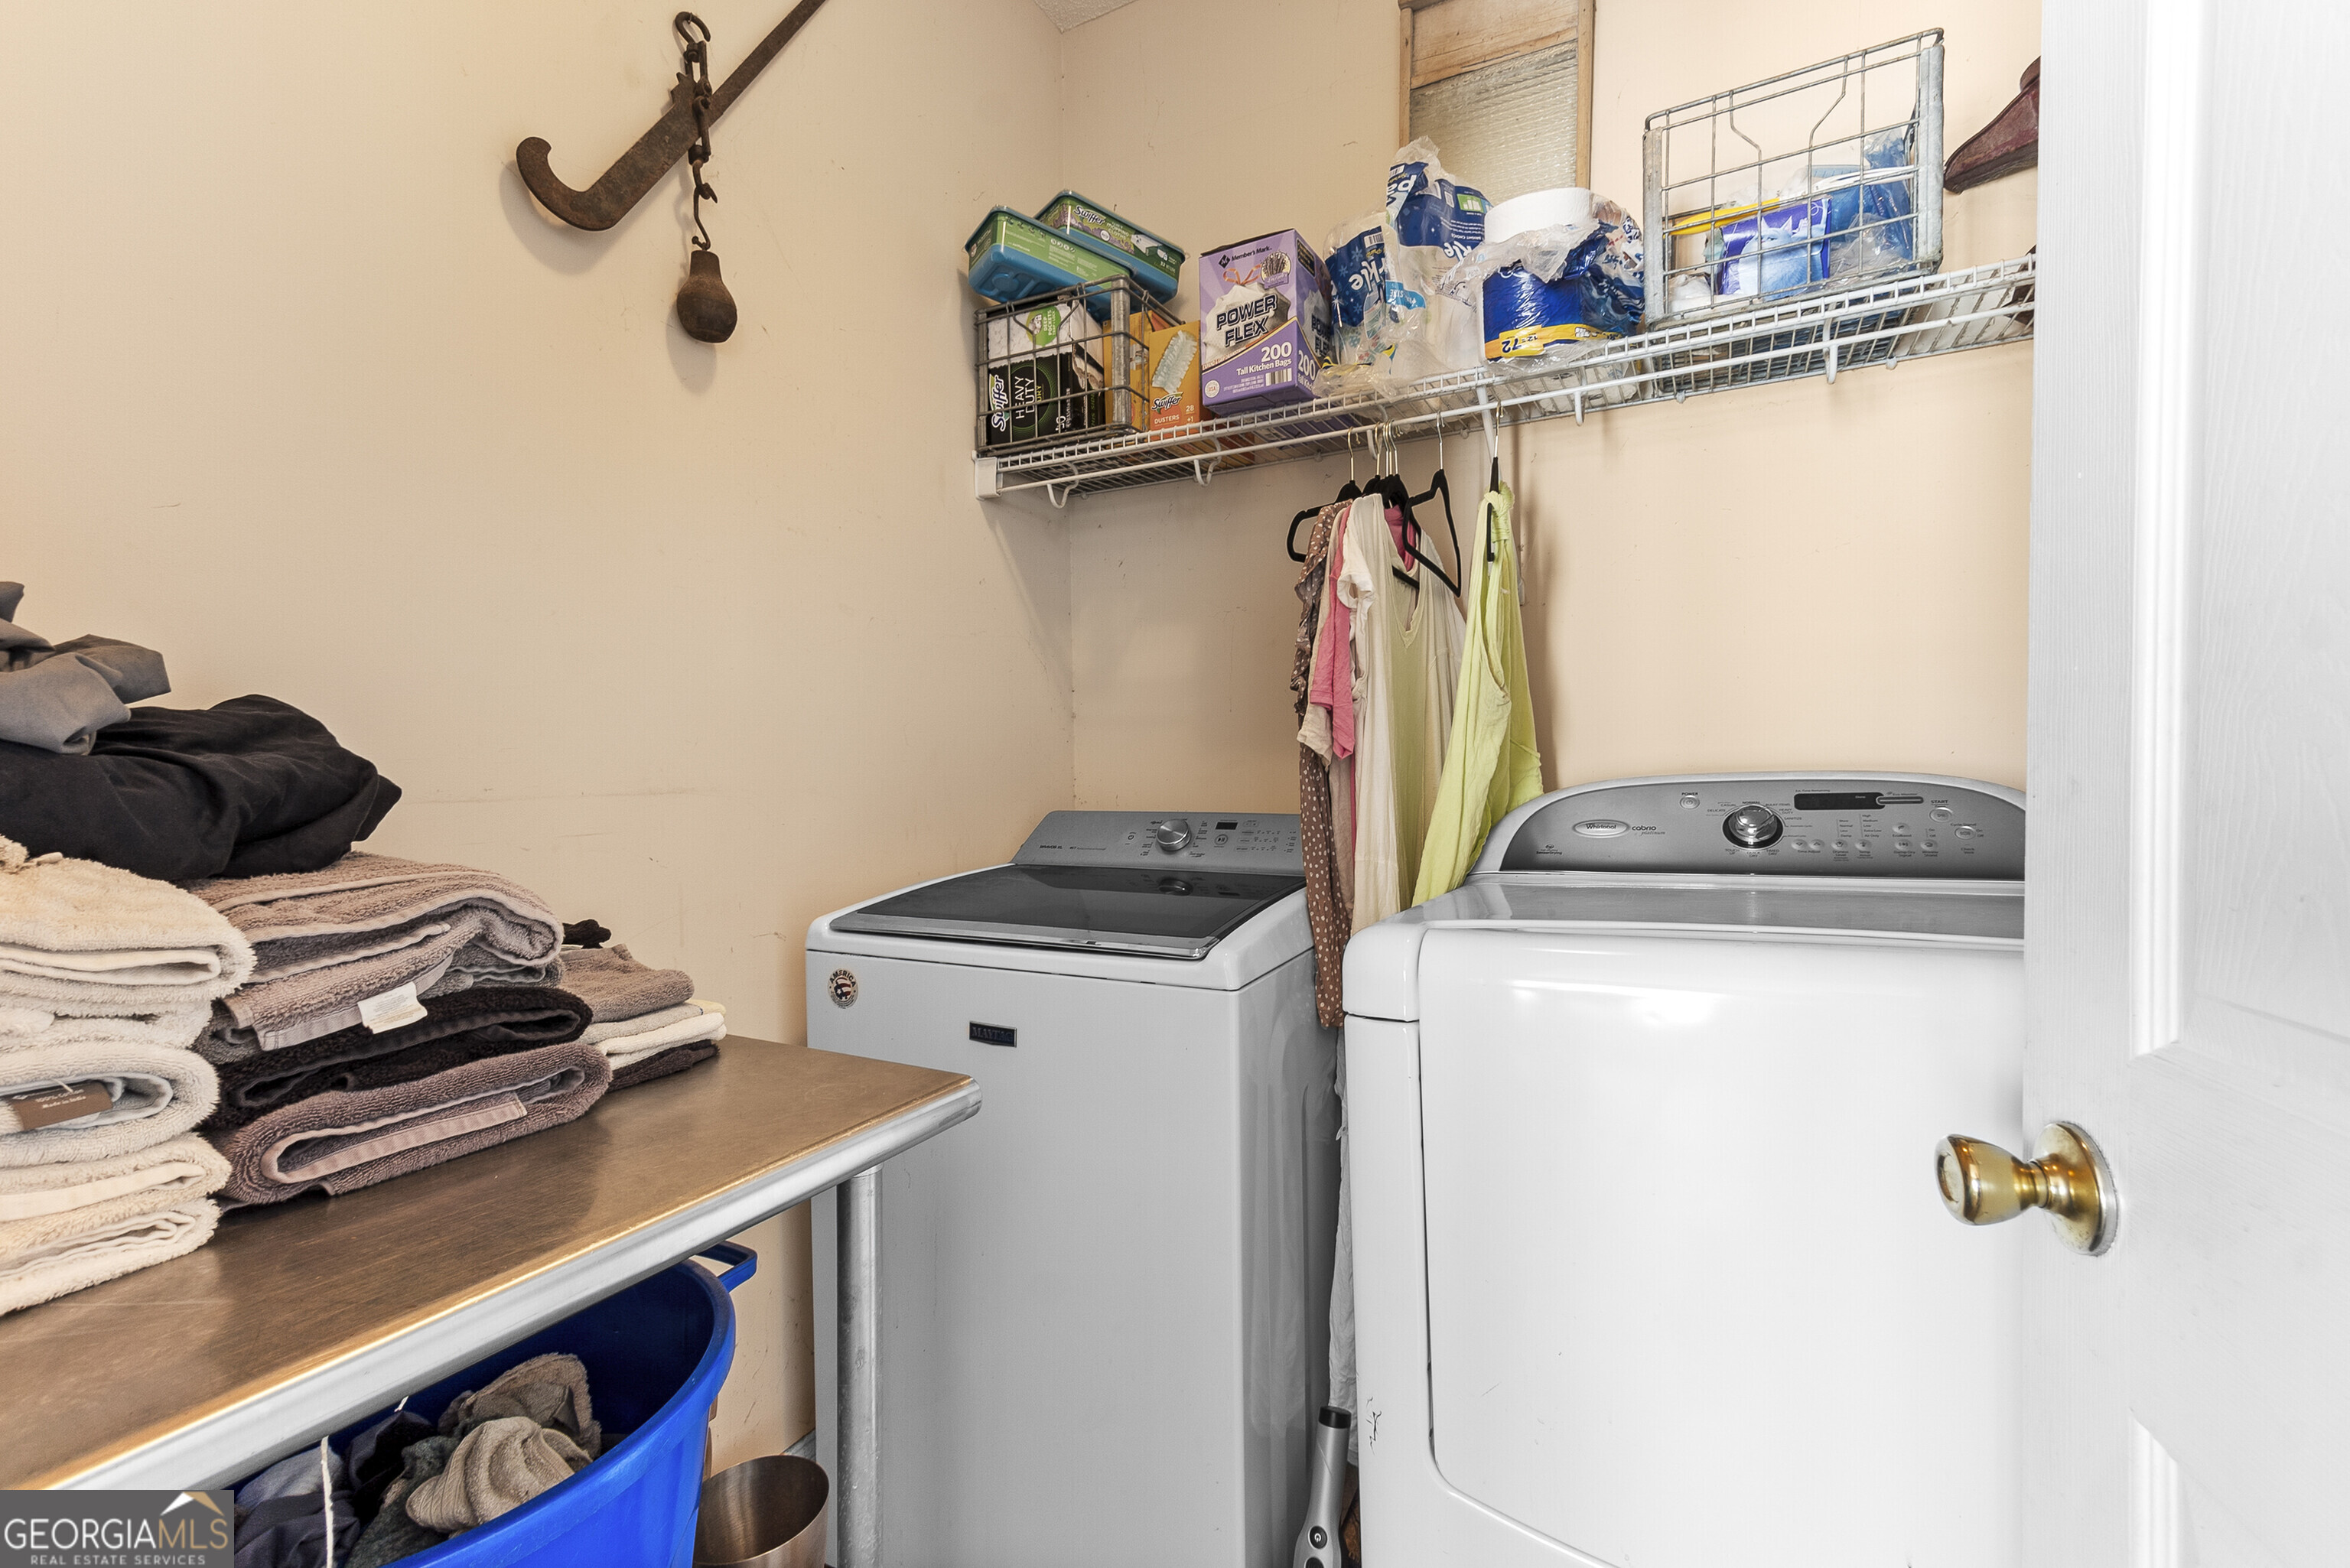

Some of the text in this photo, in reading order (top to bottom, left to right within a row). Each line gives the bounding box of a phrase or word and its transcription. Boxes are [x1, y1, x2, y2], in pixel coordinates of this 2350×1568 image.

[1073, 204, 1106, 226] Swiffer
[1231, 245, 1270, 262] Member's Mark
[1216, 294, 1278, 330] POWER
[1225, 316, 1269, 347] FLEX
[1261, 341, 1292, 363] 200
[1502, 339, 1522, 353] 72
[1236, 359, 1291, 376] Tall Kitchen Bags
[1298, 350, 1316, 381] 200
[991, 374, 1009, 431] Swiffer
[1014, 376, 1025, 419] HEAVY
[1025, 378, 1035, 414] DUTY
[1151, 395, 1181, 411] Swiffer
[1154, 415, 1180, 425] DUSTERS
[829, 970, 856, 987] AMERICA
[972, 1026, 1014, 1042] MAYTAG
